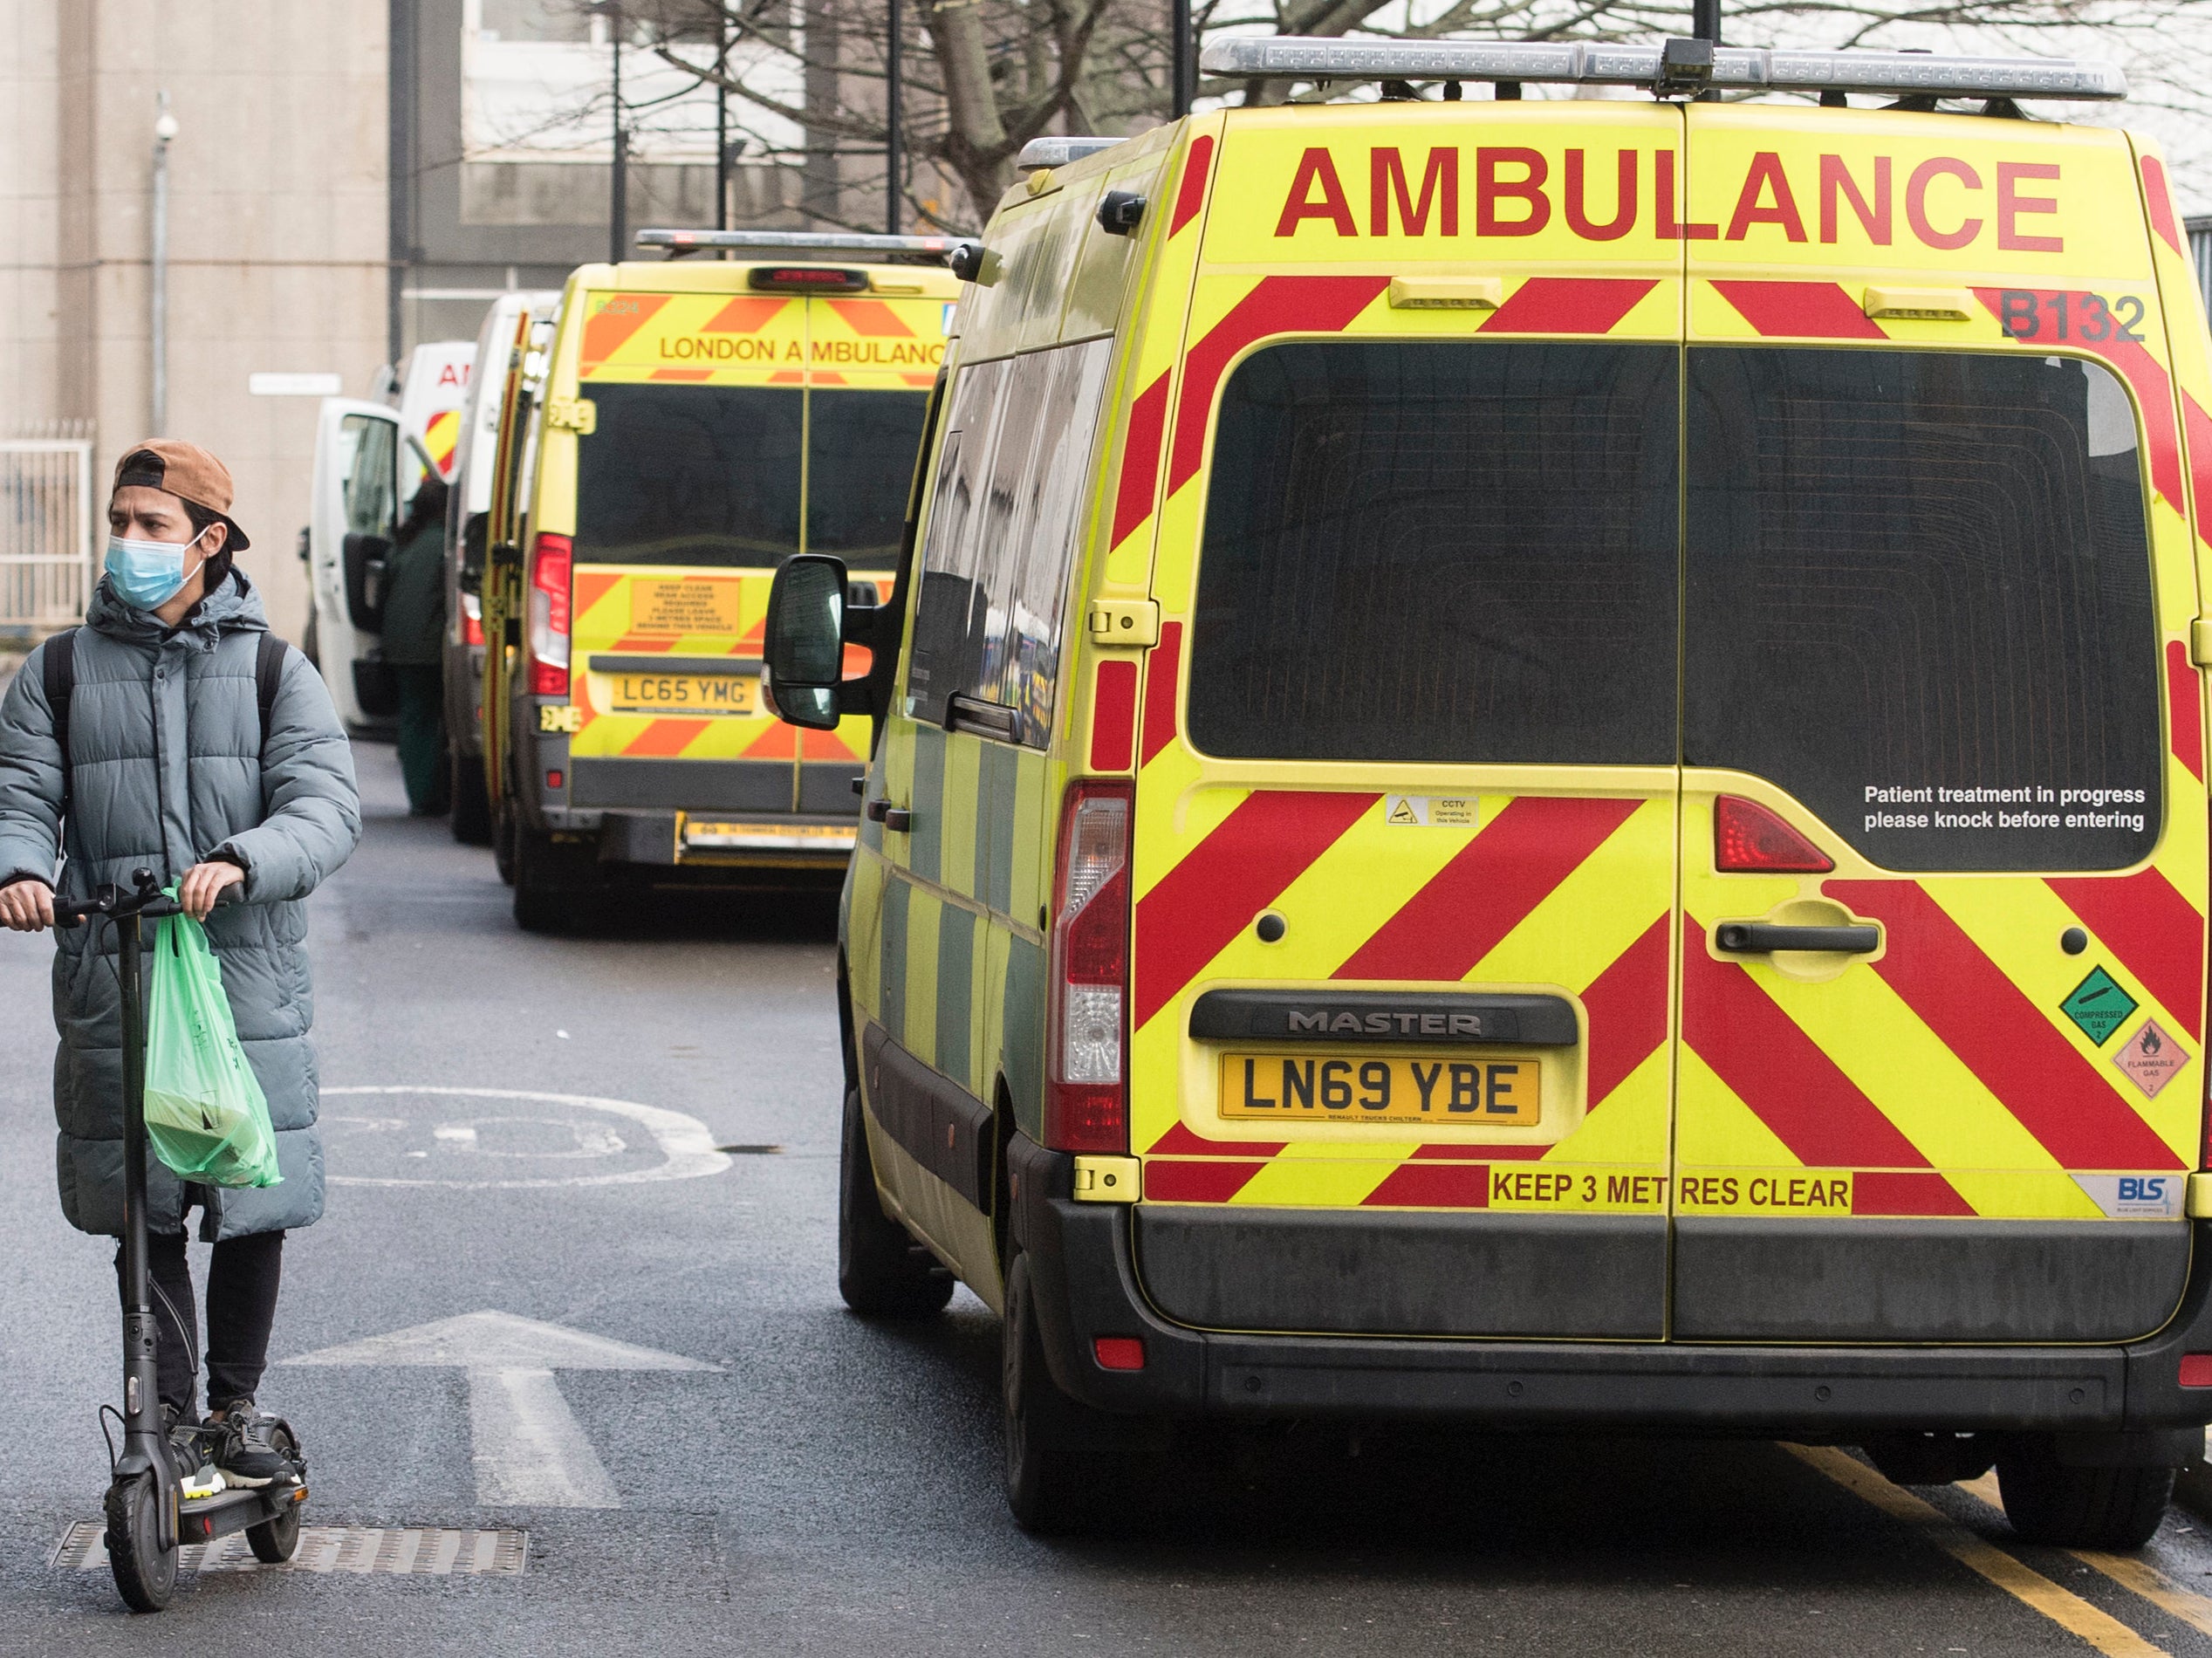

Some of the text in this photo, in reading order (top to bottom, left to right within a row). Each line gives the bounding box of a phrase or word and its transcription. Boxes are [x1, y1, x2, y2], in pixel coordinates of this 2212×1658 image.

[1273, 146, 2065, 253] AMBULANCE
[2000, 290, 2146, 342] B132
[660, 337, 946, 366] LONDON AMBULANC
[623, 679, 745, 703] LC65 YMG
[1864, 785, 2147, 806] Patient treatment in progress
[1864, 811, 2145, 832] please knock before entering
[1288, 1011, 1483, 1037] MASTER
[2074, 1010, 2123, 1019] COMPRESSED
[2091, 1020, 2106, 1029] GAS
[2127, 1059, 2175, 1068] FLAMMABLE
[1243, 1058, 1519, 1115] LN69 YBE
[1493, 1173, 1849, 1209] KEEP 3 METRES CLEAR
[2118, 1177, 2167, 1201] BLS
